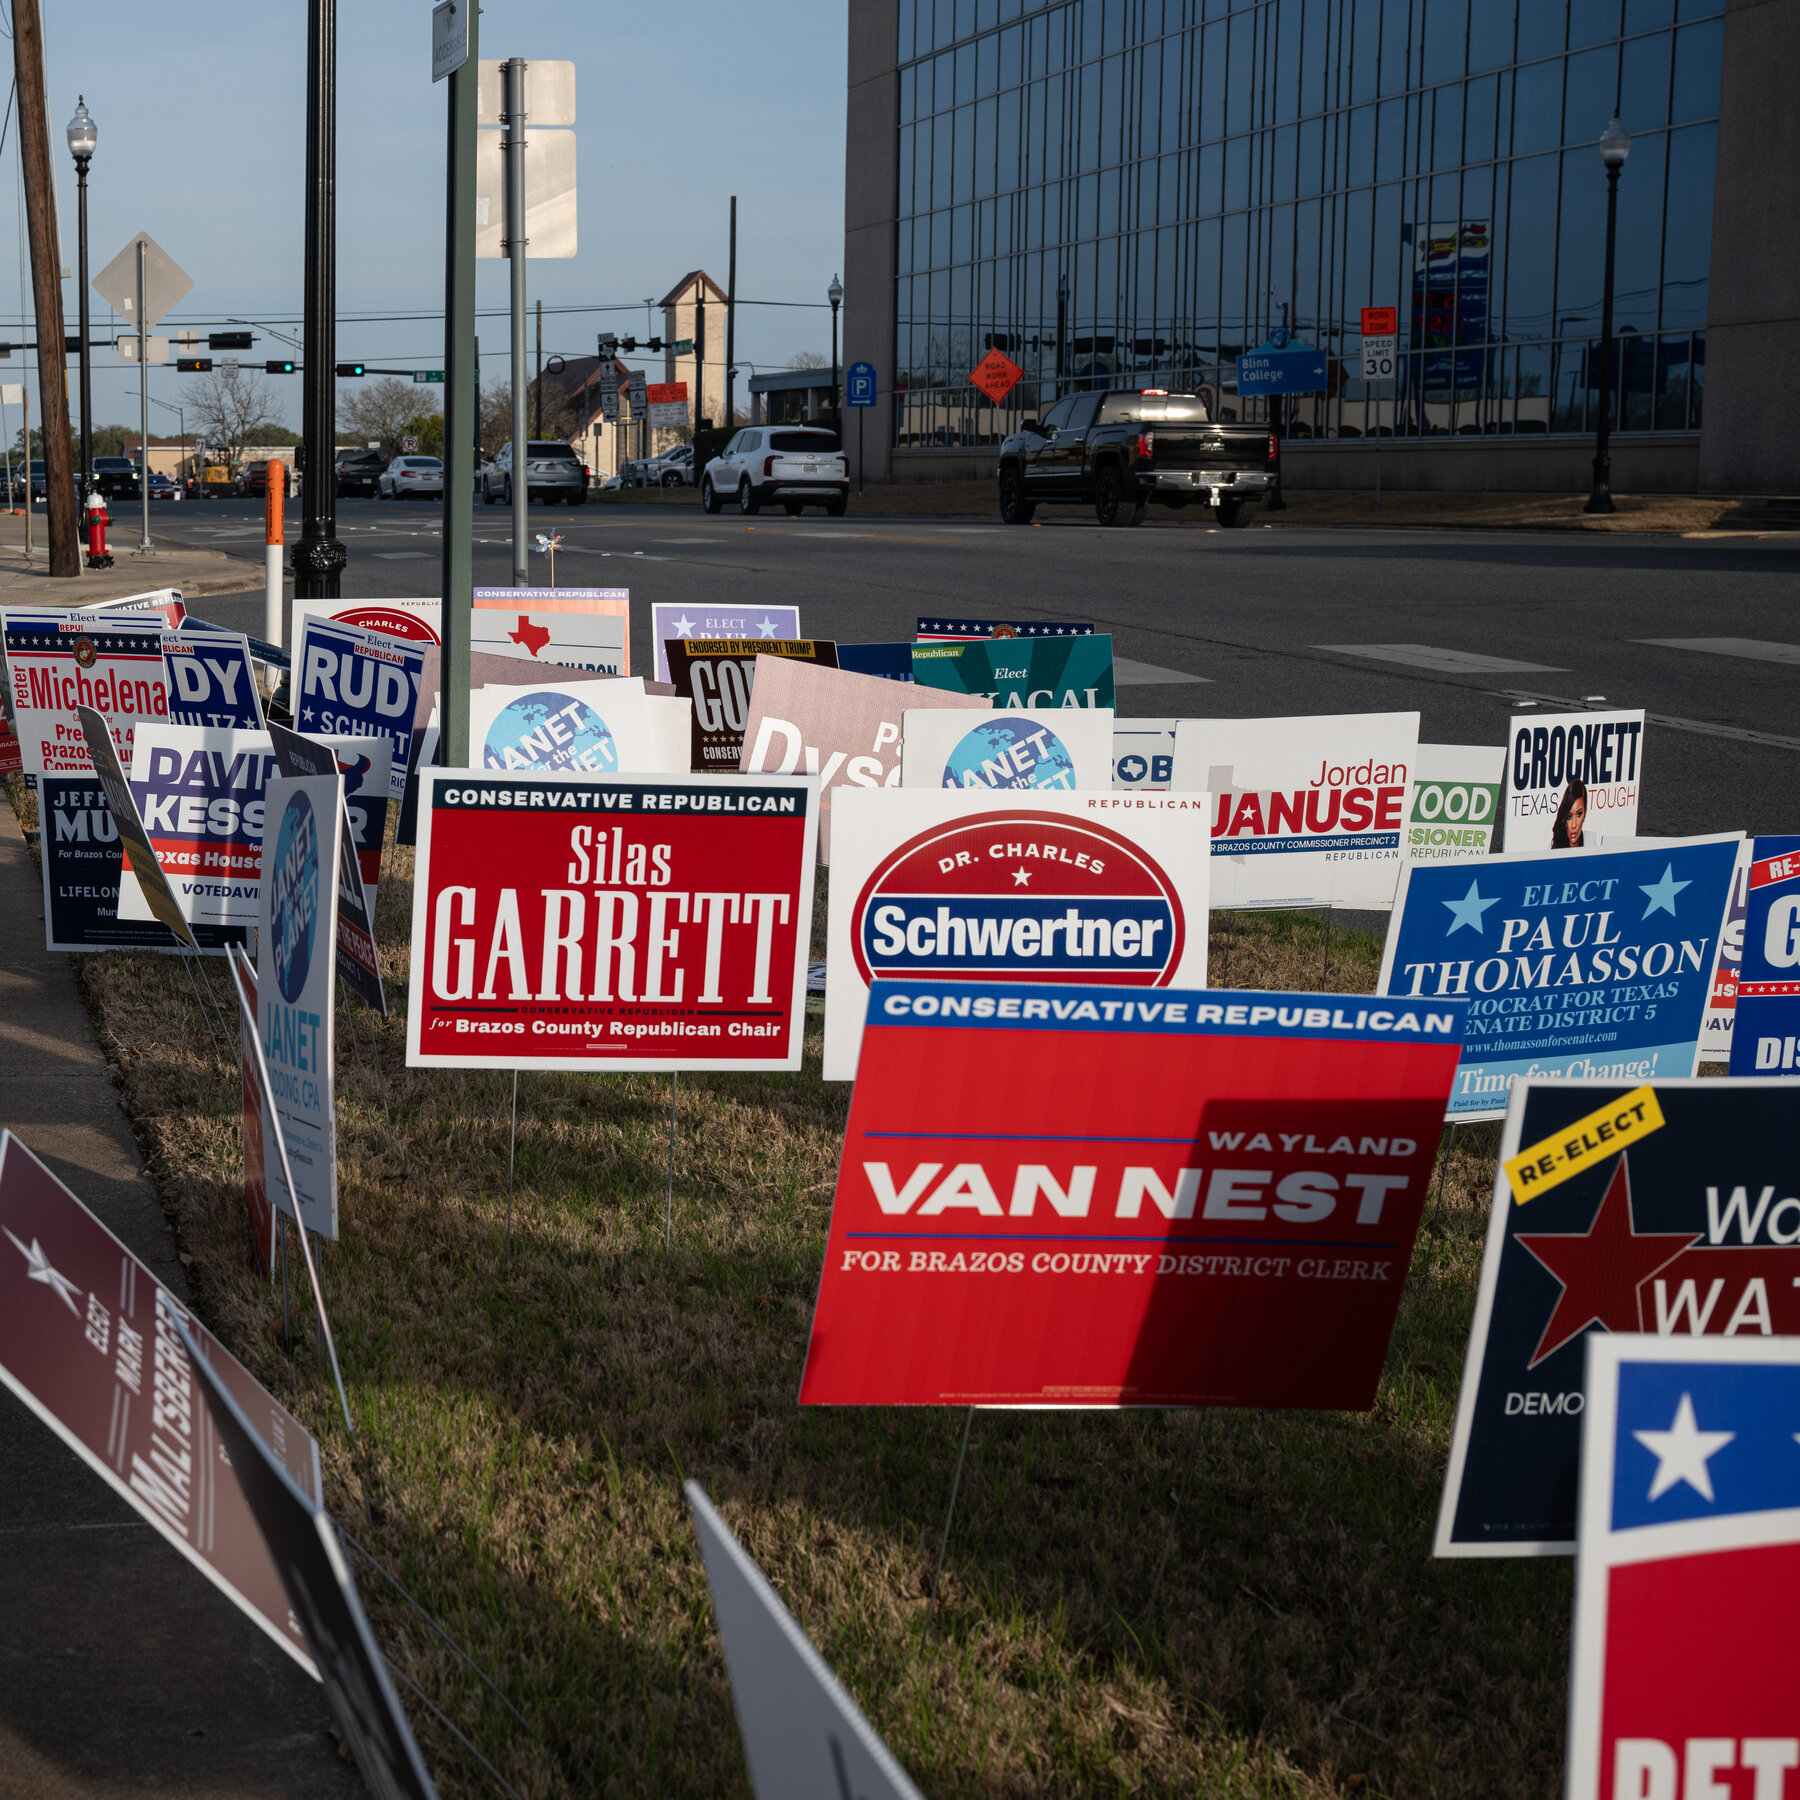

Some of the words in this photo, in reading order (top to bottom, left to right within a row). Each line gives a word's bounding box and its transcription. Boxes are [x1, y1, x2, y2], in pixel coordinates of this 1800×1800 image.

[1368, 312, 1389, 320] WORK
[1368, 322, 1389, 330] ZONE
[1364, 340, 1393, 348] SPEED
[986, 372, 1007, 380] WORK
[1242, 358, 1270, 369] Blinn
[1242, 368, 1284, 382] College
[1366, 359, 1392, 375] 30
[984, 380, 1010, 389] AHEAD
[70, 613, 96, 622] Elect
[358, 620, 408, 633] CHARLES
[705, 618, 746, 629] ELECT
[355, 645, 404, 664] REPUBLICAN
[367, 635, 392, 649] Elect
[688, 641, 729, 653] ENDORSED
[730, 642, 740, 653] BY
[742, 642, 783, 654] PRESIDENT
[785, 642, 811, 655] TRUMP
[912, 649, 958, 659] Republican
[993, 667, 1027, 680] Elect
[14, 665, 30, 708] Peter
[29, 666, 168, 716] Michelena
[873, 722, 901, 758] P
[552, 745, 577, 765] the
[1513, 721, 1641, 791] CROCKETT
[1310, 758, 1407, 788] Jordan
[444, 788, 633, 809] CONSERVATIVE
[642, 794, 796, 812] REPUBLICAN
[1088, 799, 1201, 809] REPUBLICAN
[1211, 786, 1405, 838] JANUSE
[1512, 792, 1559, 817] TEXAS
[1588, 786, 1636, 810] TOUGH
[58, 850, 72, 858] For
[75, 850, 103, 859] Brazos
[567, 825, 672, 887] Silas
[1217, 843, 1250, 852] BRAZOS
[1252, 841, 1285, 850] COUNTY
[1287, 838, 1349, 849] COMMISSIONER
[1350, 836, 1389, 845] PRECINCT
[1391, 836, 1396, 844] 2
[1326, 851, 1399, 861] REPUBLICAN
[271, 810, 313, 926] JANET
[937, 850, 979, 874] DR.
[988, 843, 1105, 876] CHARLES
[1522, 878, 1619, 908] ELECT
[275, 871, 318, 980] PLANET
[872, 904, 1163, 957] Schwertner
[1496, 910, 1622, 953] PAUL
[353, 928, 374, 969] PEACE
[431, 884, 791, 1005] GARRETT
[1403, 937, 1710, 997] THOMASSON
[1563, 989, 1606, 1009] FOR
[1611, 982, 1680, 1003] TEXAS
[521, 1006, 614, 1017] CONSERVATIVE
[618, 1007, 696, 1017] REPUBLICAN
[883, 994, 1188, 1026] CONSERVATIVE
[1197, 1003, 1455, 1035] REPUBLICAN
[1536, 1004, 1640, 1031] DISTRICT
[1645, 1004, 1657, 1021] 5
[264, 1001, 320, 1075] JANET
[429, 1017, 453, 1031] for
[456, 1018, 526, 1035] Brazos
[530, 1020, 603, 1038] County
[609, 1021, 721, 1040] Republican
[726, 1022, 781, 1038] Chair
[1466, 1031, 1618, 1054] www.thomassonforsenate.com
[1459, 1068, 1520, 1095] Time
[1566, 1052, 1659, 1078] Change!
[302, 1079, 320, 1112] CPA
[1481, 1100, 1489, 1108] by
[1491, 1097, 1506, 1105] Paul
[1208, 1129, 1419, 1157] WAYLAND
[1518, 1101, 1648, 1188] RE-ELECT
[862, 1161, 1098, 1218] VAN
[1114, 1166, 1410, 1225] NEST
[840, 1249, 902, 1272] FOR
[908, 1250, 1025, 1274] BRAZOS
[1031, 1251, 1153, 1275] COUNTY
[1156, 1254, 1293, 1278] DISTRICT
[1296, 1257, 1391, 1281] CLERK
[1653, 1277, 1800, 1337] WA
[84, 1291, 111, 1356] ELECT
[115, 1315, 143, 1396] MARK
